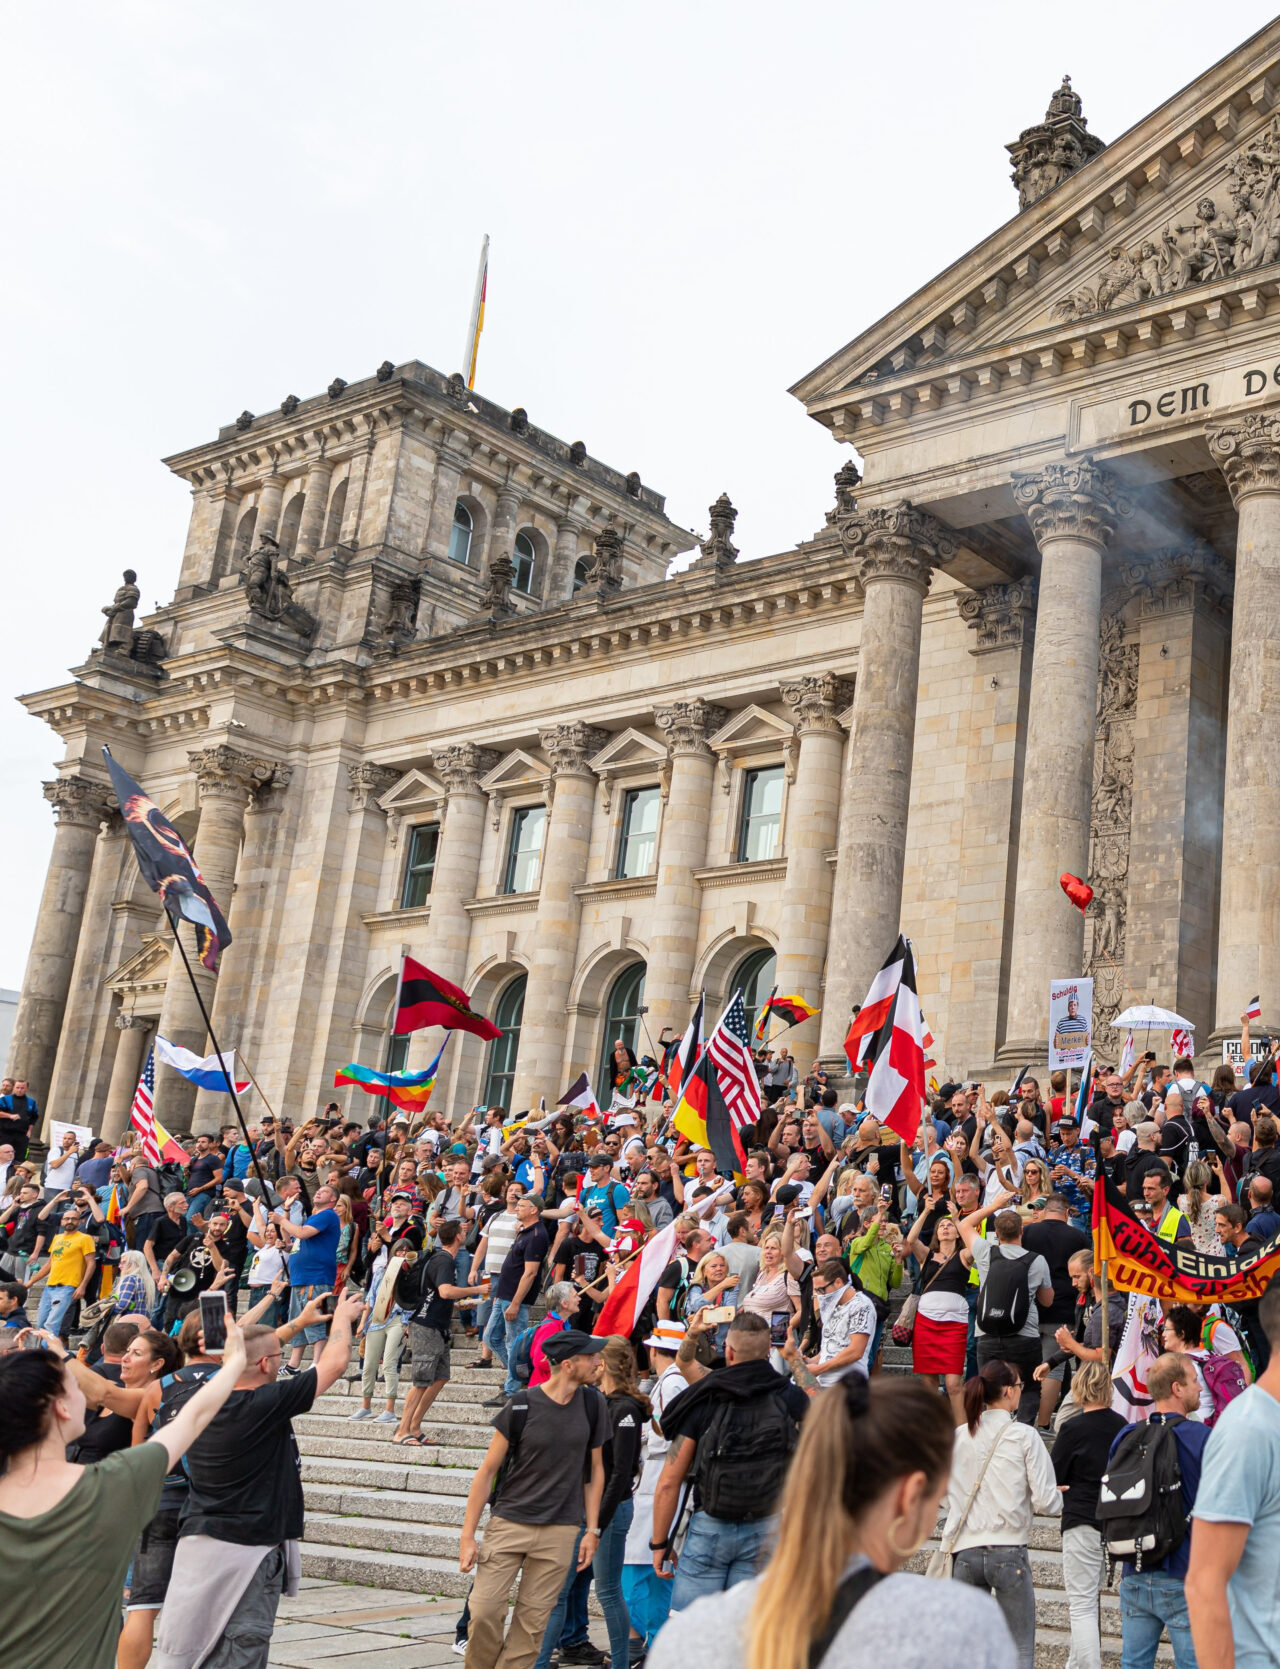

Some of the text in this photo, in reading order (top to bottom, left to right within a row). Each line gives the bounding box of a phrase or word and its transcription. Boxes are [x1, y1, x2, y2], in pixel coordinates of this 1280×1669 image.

[1129, 383, 1209, 425] DEM
[1051, 985, 1078, 1000] Schuldig
[1061, 1036, 1084, 1045] Merkel
[1115, 1263, 1177, 1298] und
